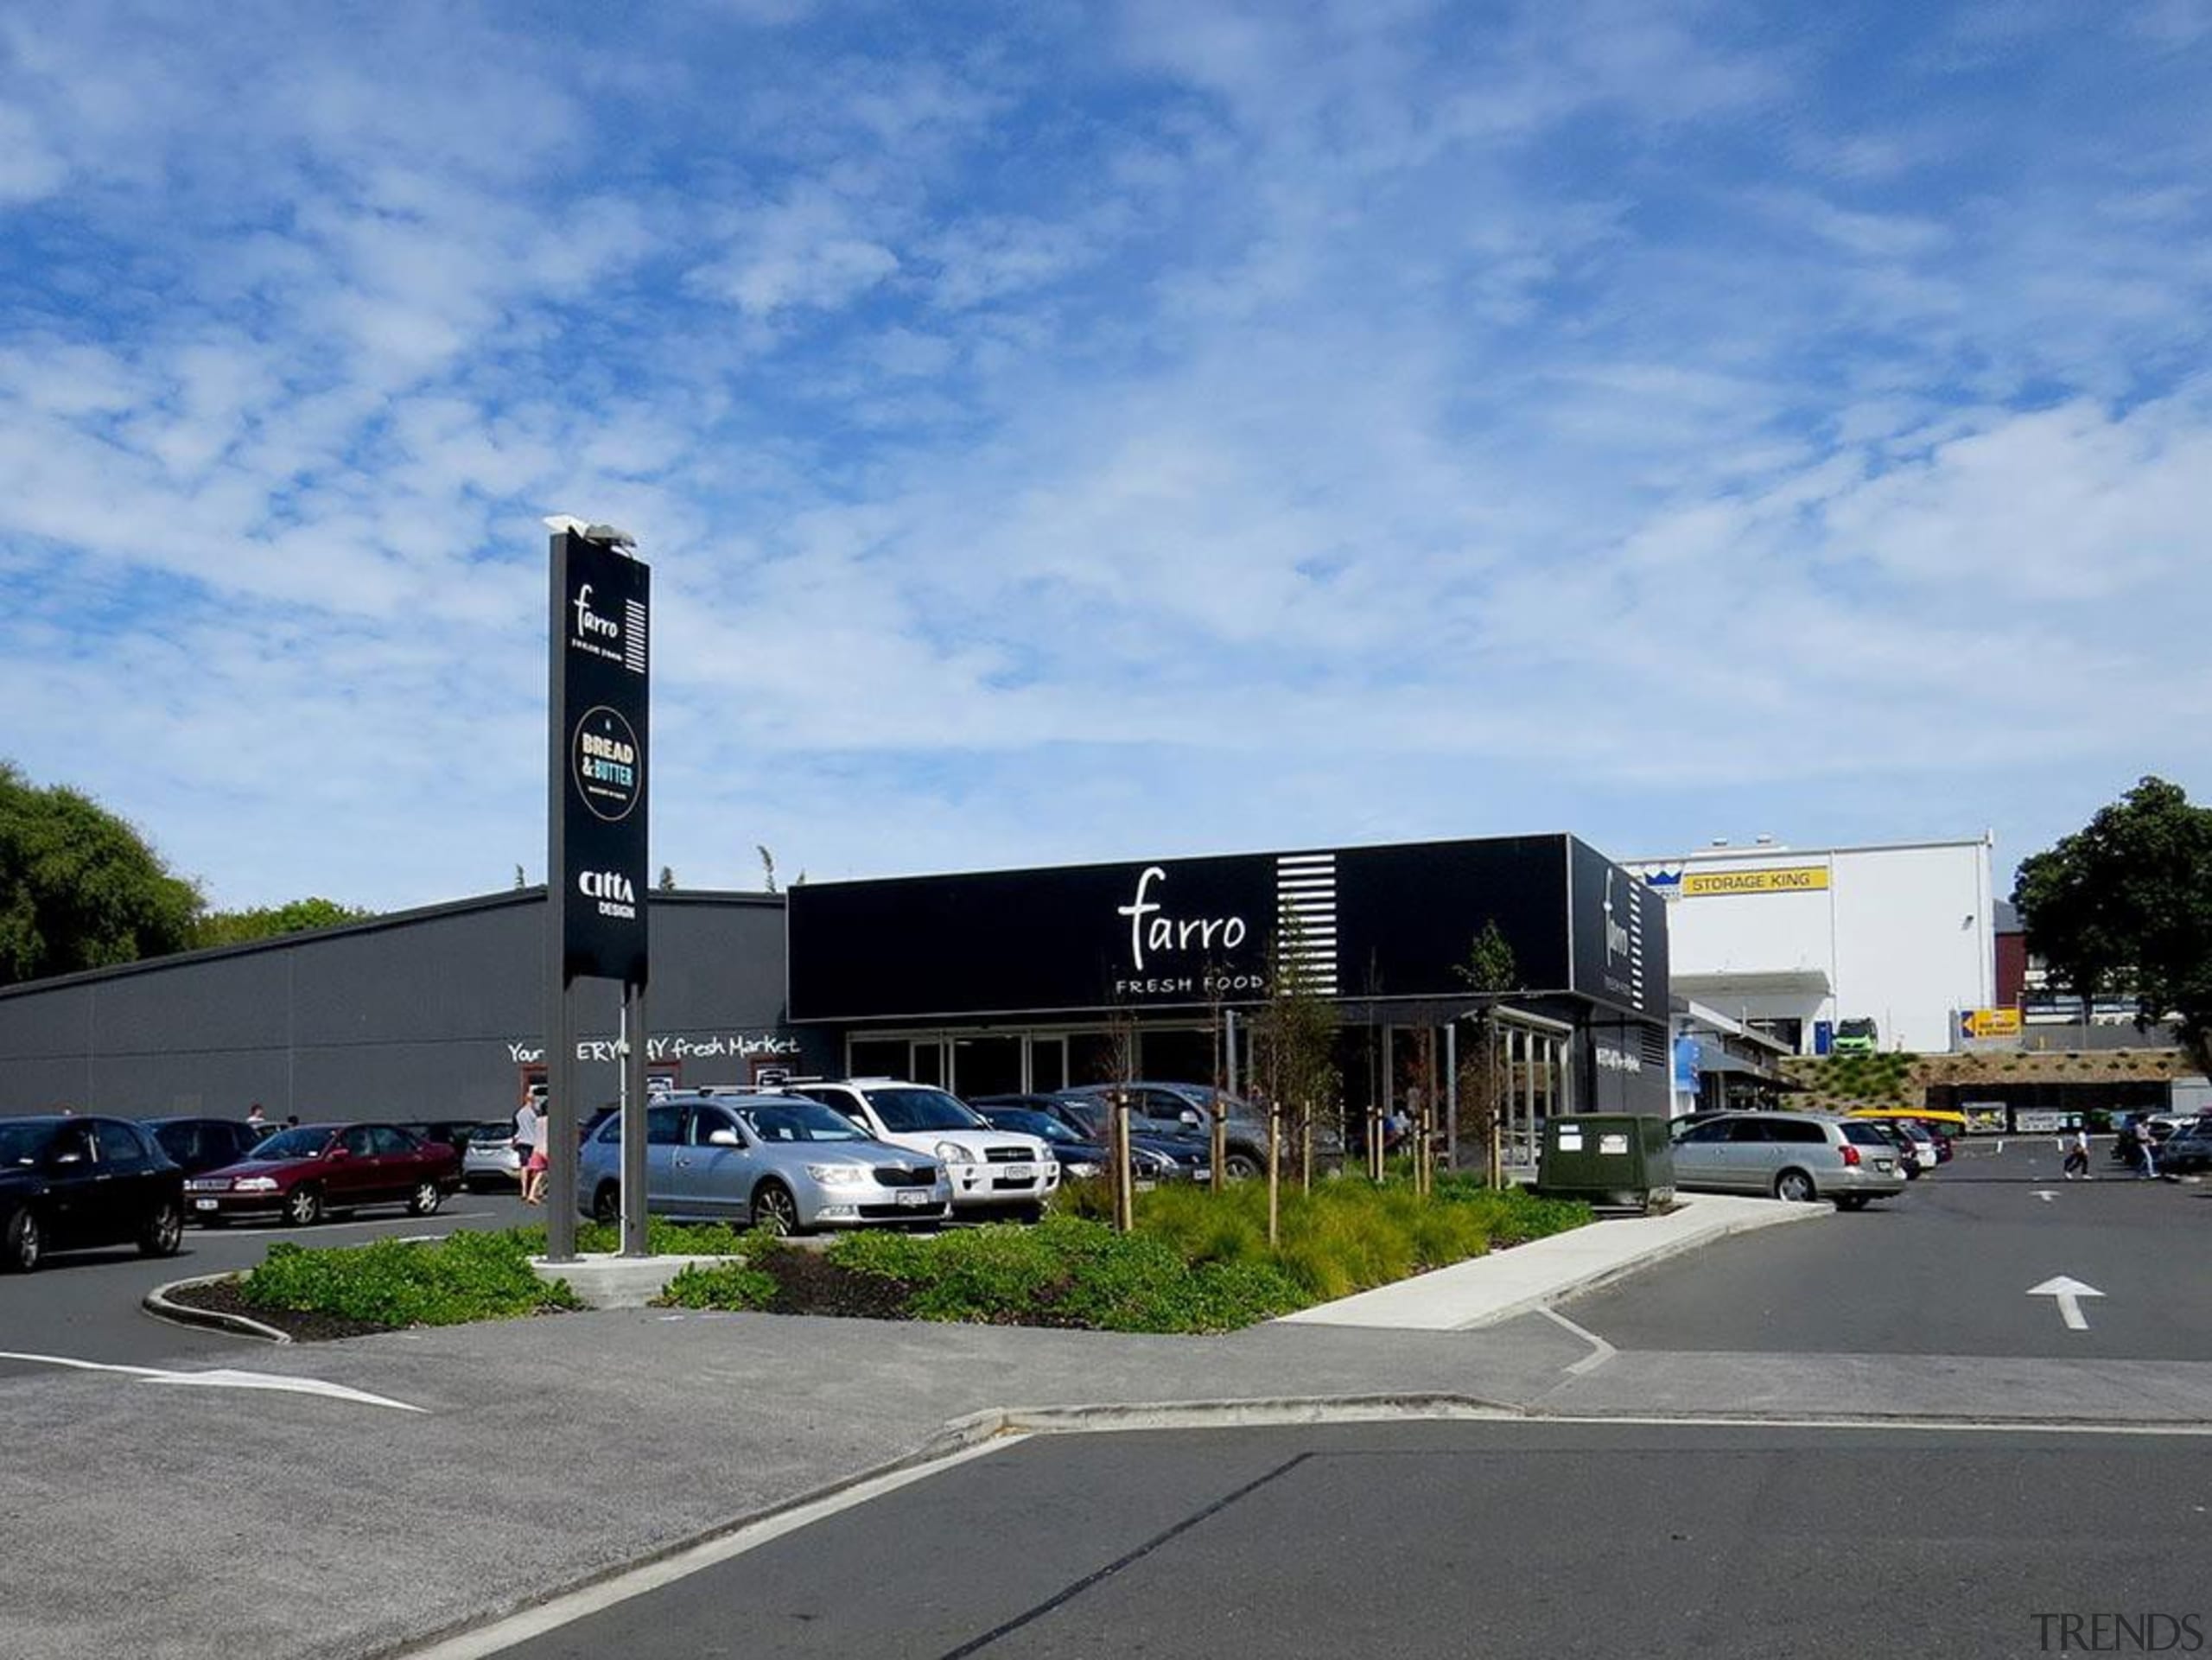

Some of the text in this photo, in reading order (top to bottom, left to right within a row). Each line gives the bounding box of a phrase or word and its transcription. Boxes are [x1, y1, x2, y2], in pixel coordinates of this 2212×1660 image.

[574, 584, 619, 638] farro
[582, 733, 634, 765] BREAD
[1693, 872, 1811, 892] STORAGE KING
[1117, 866, 1246, 970] farro
[1116, 974, 1264, 995] FRESH FOOD
[508, 1042, 545, 1062] Your
[671, 1037, 726, 1059] fresh
[729, 1034, 802, 1059] Market
